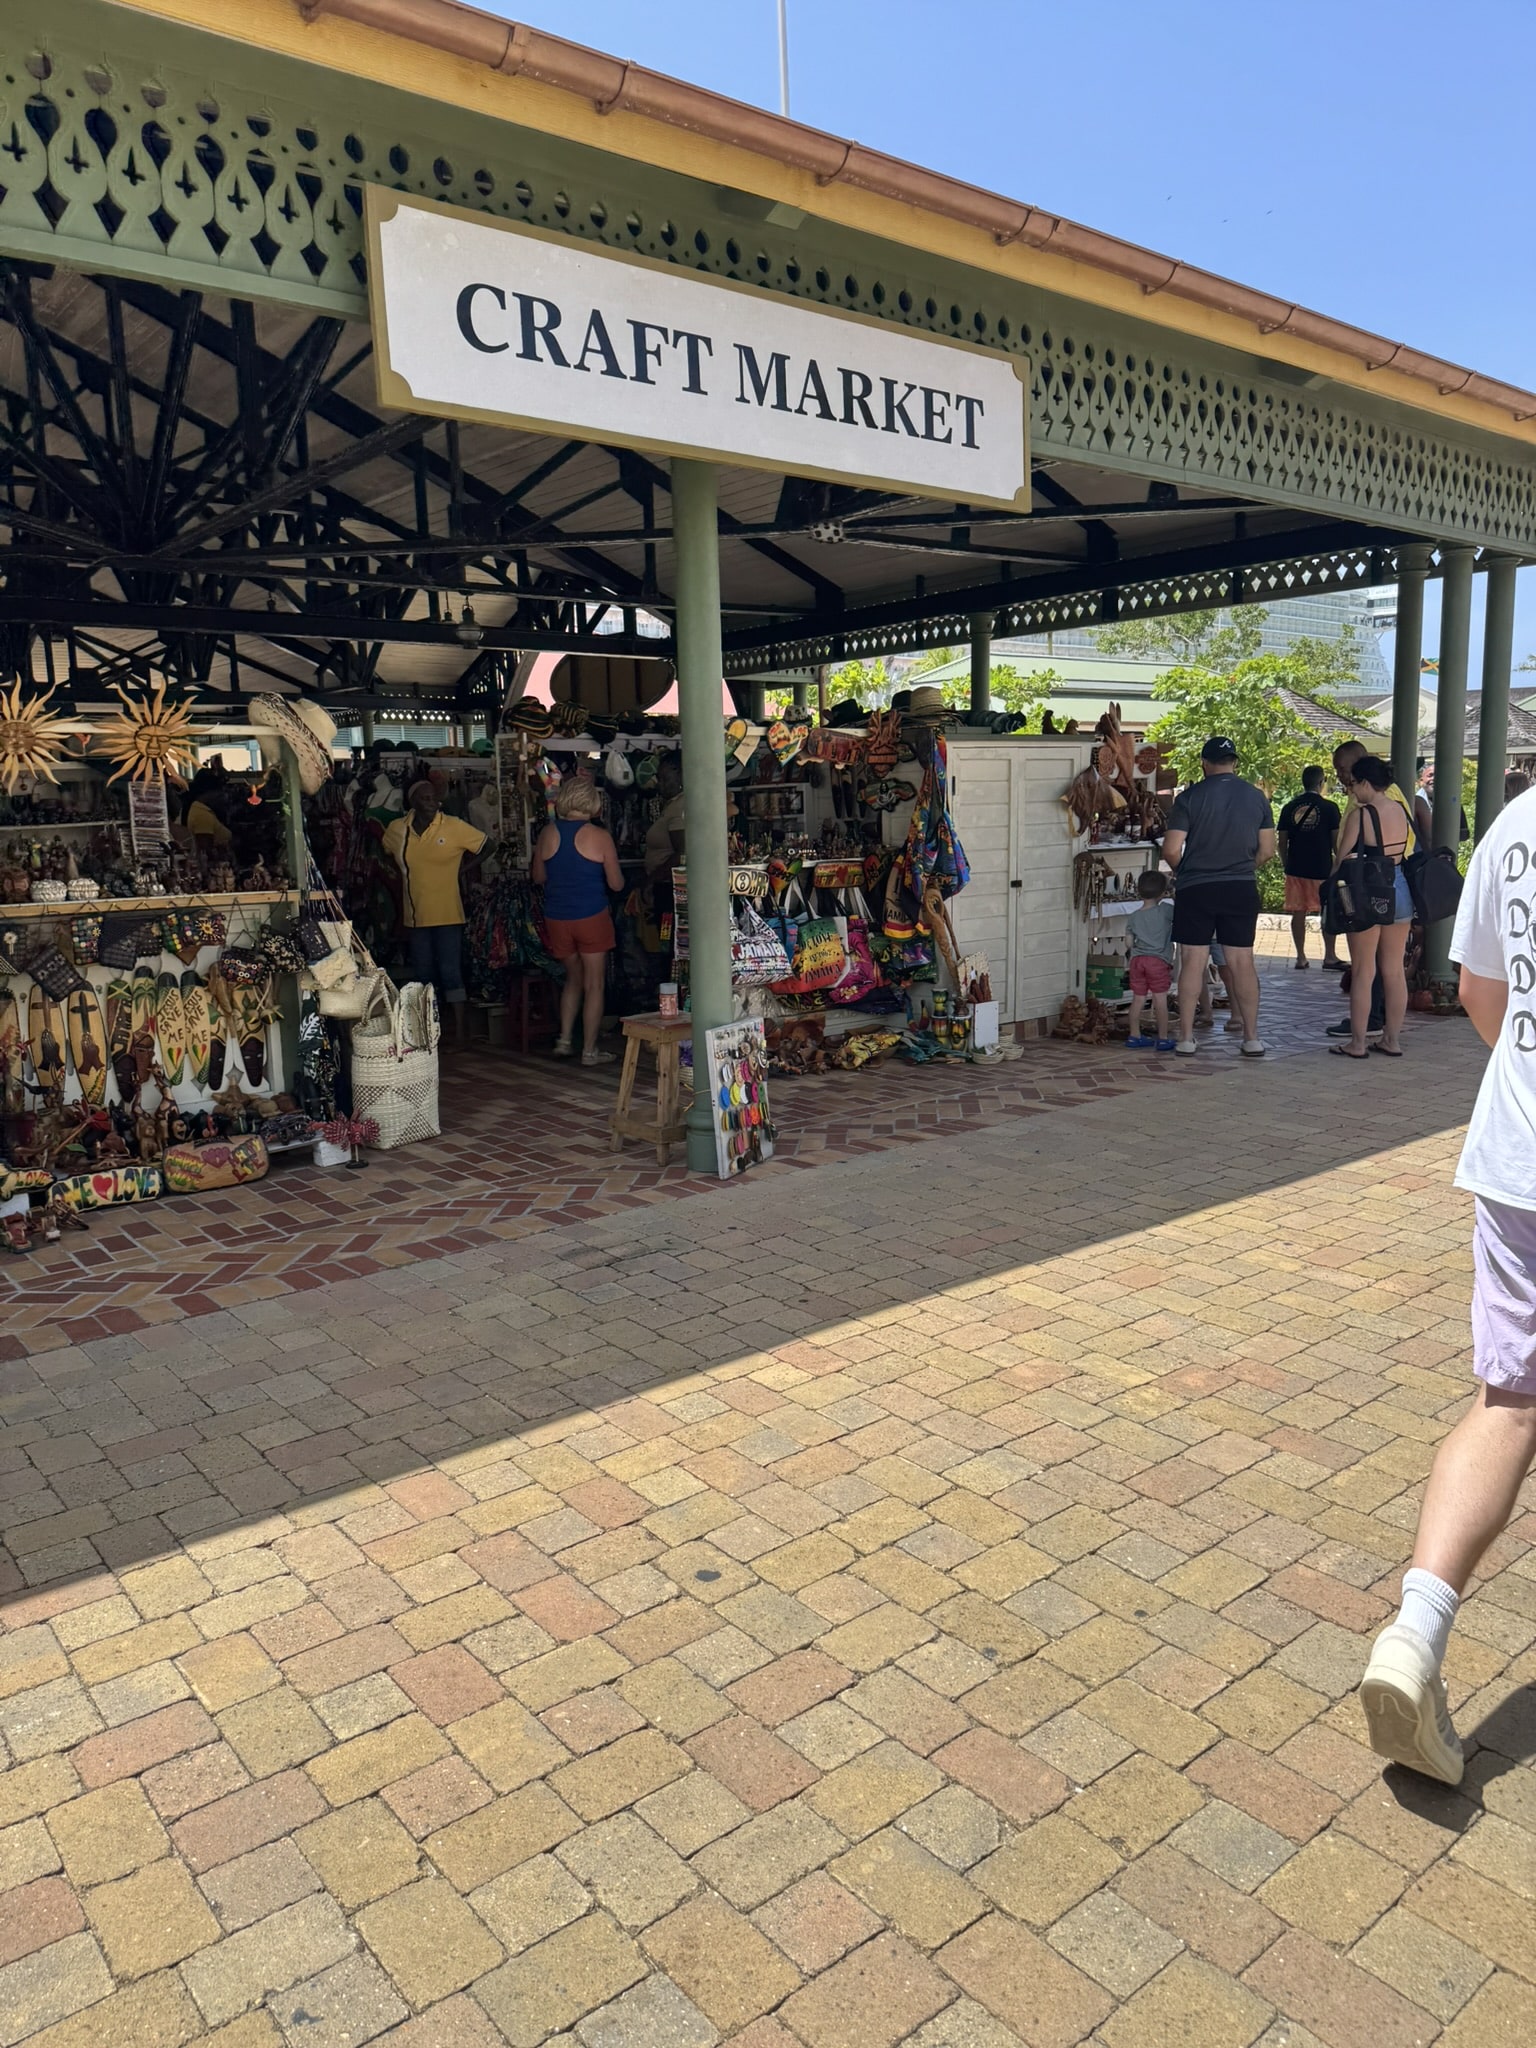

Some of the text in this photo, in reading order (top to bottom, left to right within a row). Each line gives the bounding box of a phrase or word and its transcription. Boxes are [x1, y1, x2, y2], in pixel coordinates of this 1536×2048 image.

[456, 283, 984, 450] CRAFT MARKET
[1503, 841, 1536, 883] D
[738, 942, 787, 960] JAMAICA
[157, 989, 179, 1022] JESUS
[160, 1006, 182, 1034] SAVE
[167, 1028, 184, 1044] ME
[191, 1030, 208, 1044] ME
[51, 1167, 156, 1209] ONE LOVE
